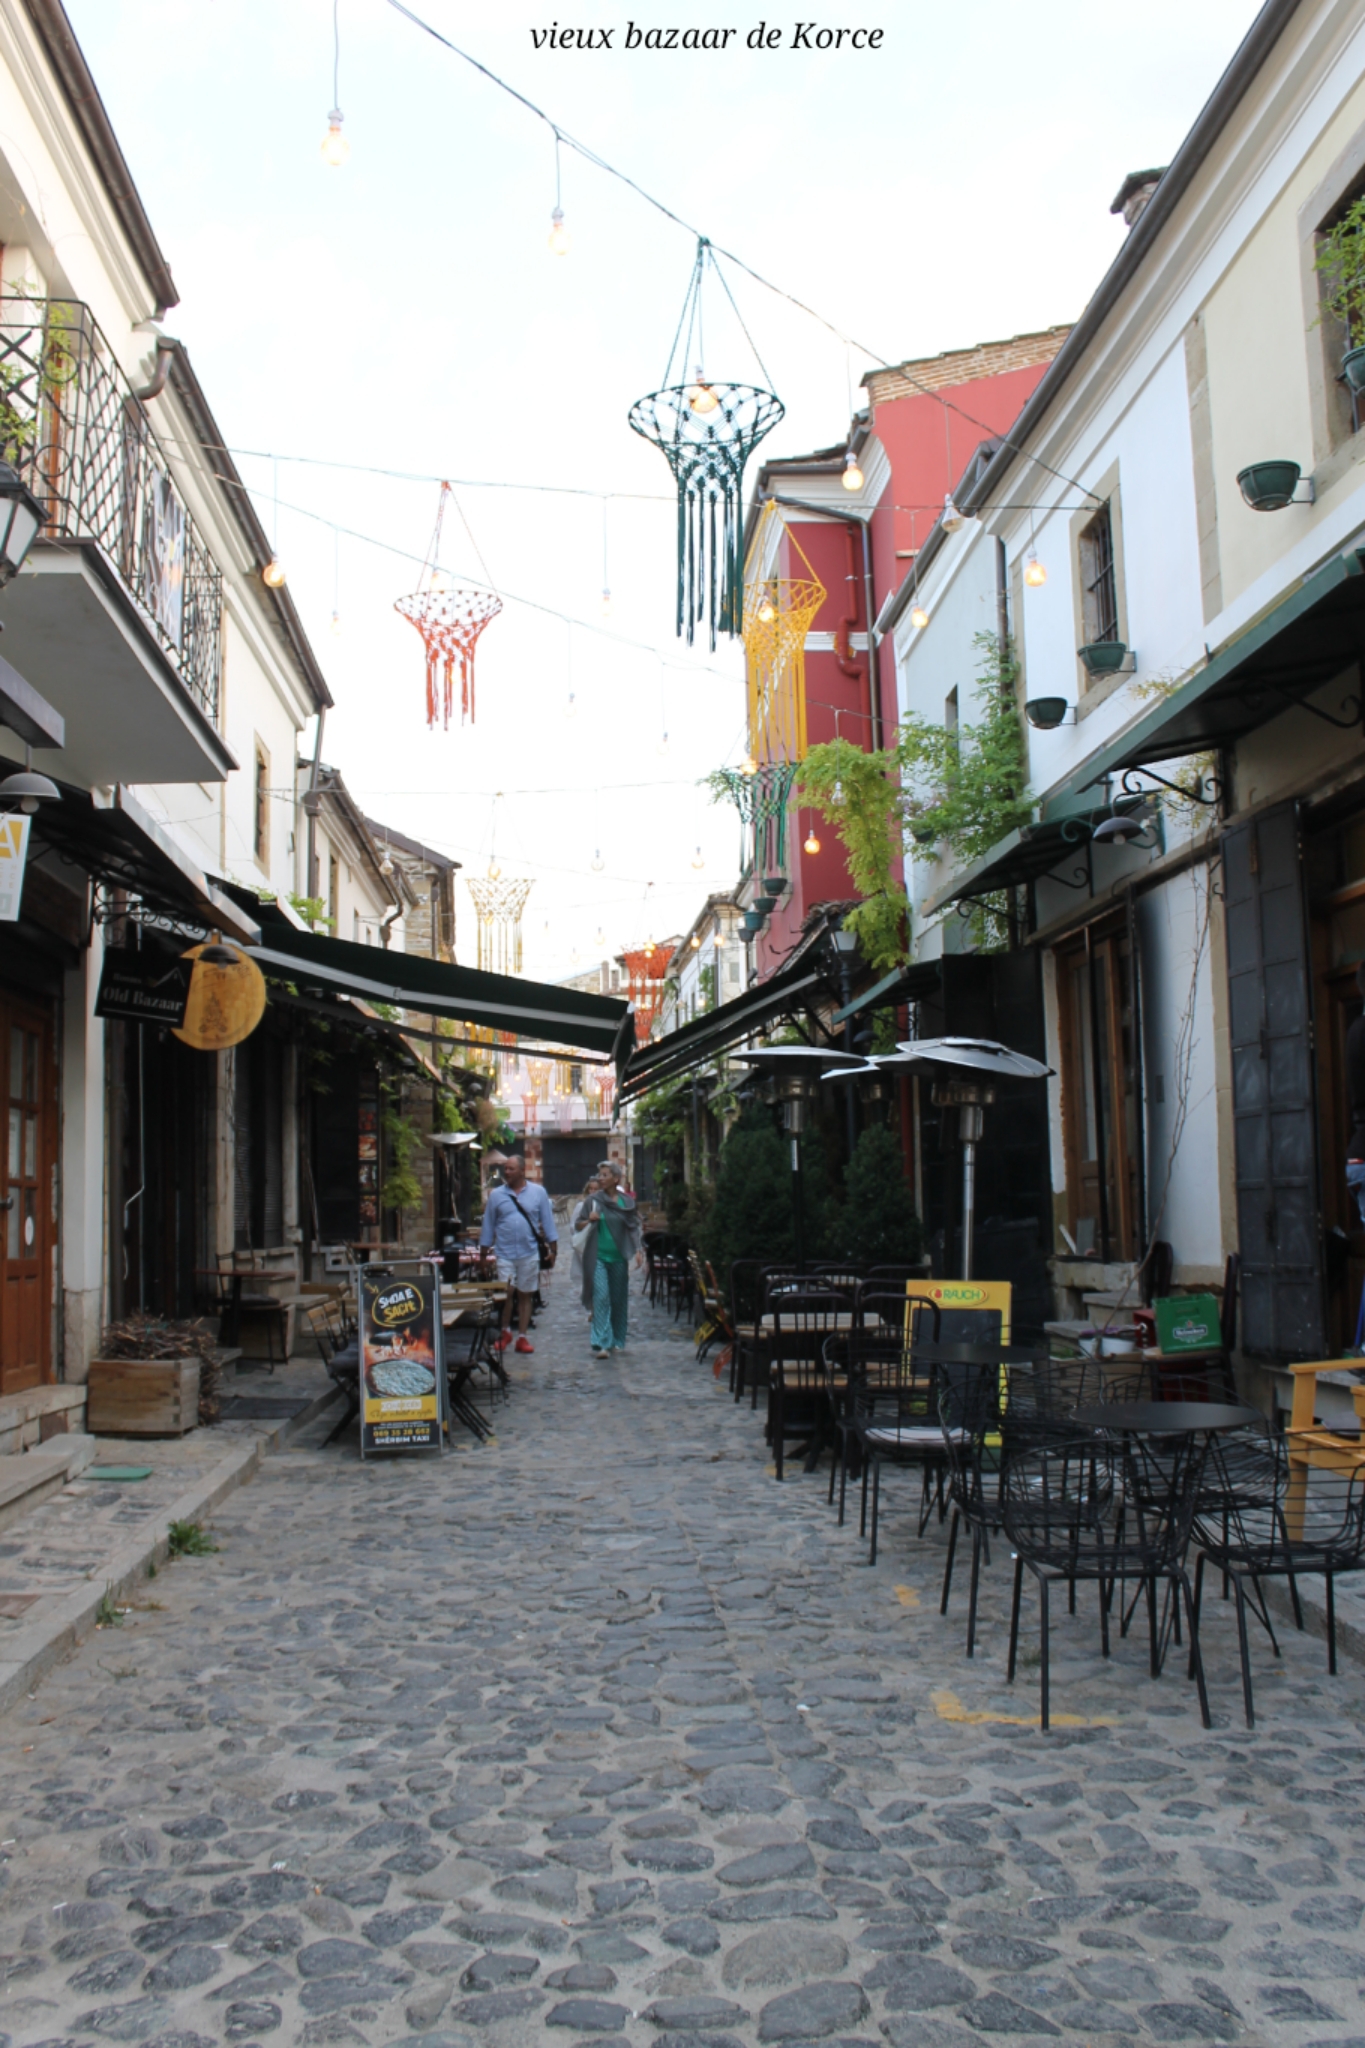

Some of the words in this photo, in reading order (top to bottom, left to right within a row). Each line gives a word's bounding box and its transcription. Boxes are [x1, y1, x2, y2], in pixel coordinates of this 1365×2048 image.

[102, 986, 130, 1003] Old
[132, 990, 185, 1012] Bazaar
[943, 1288, 981, 1300] RAUCH
